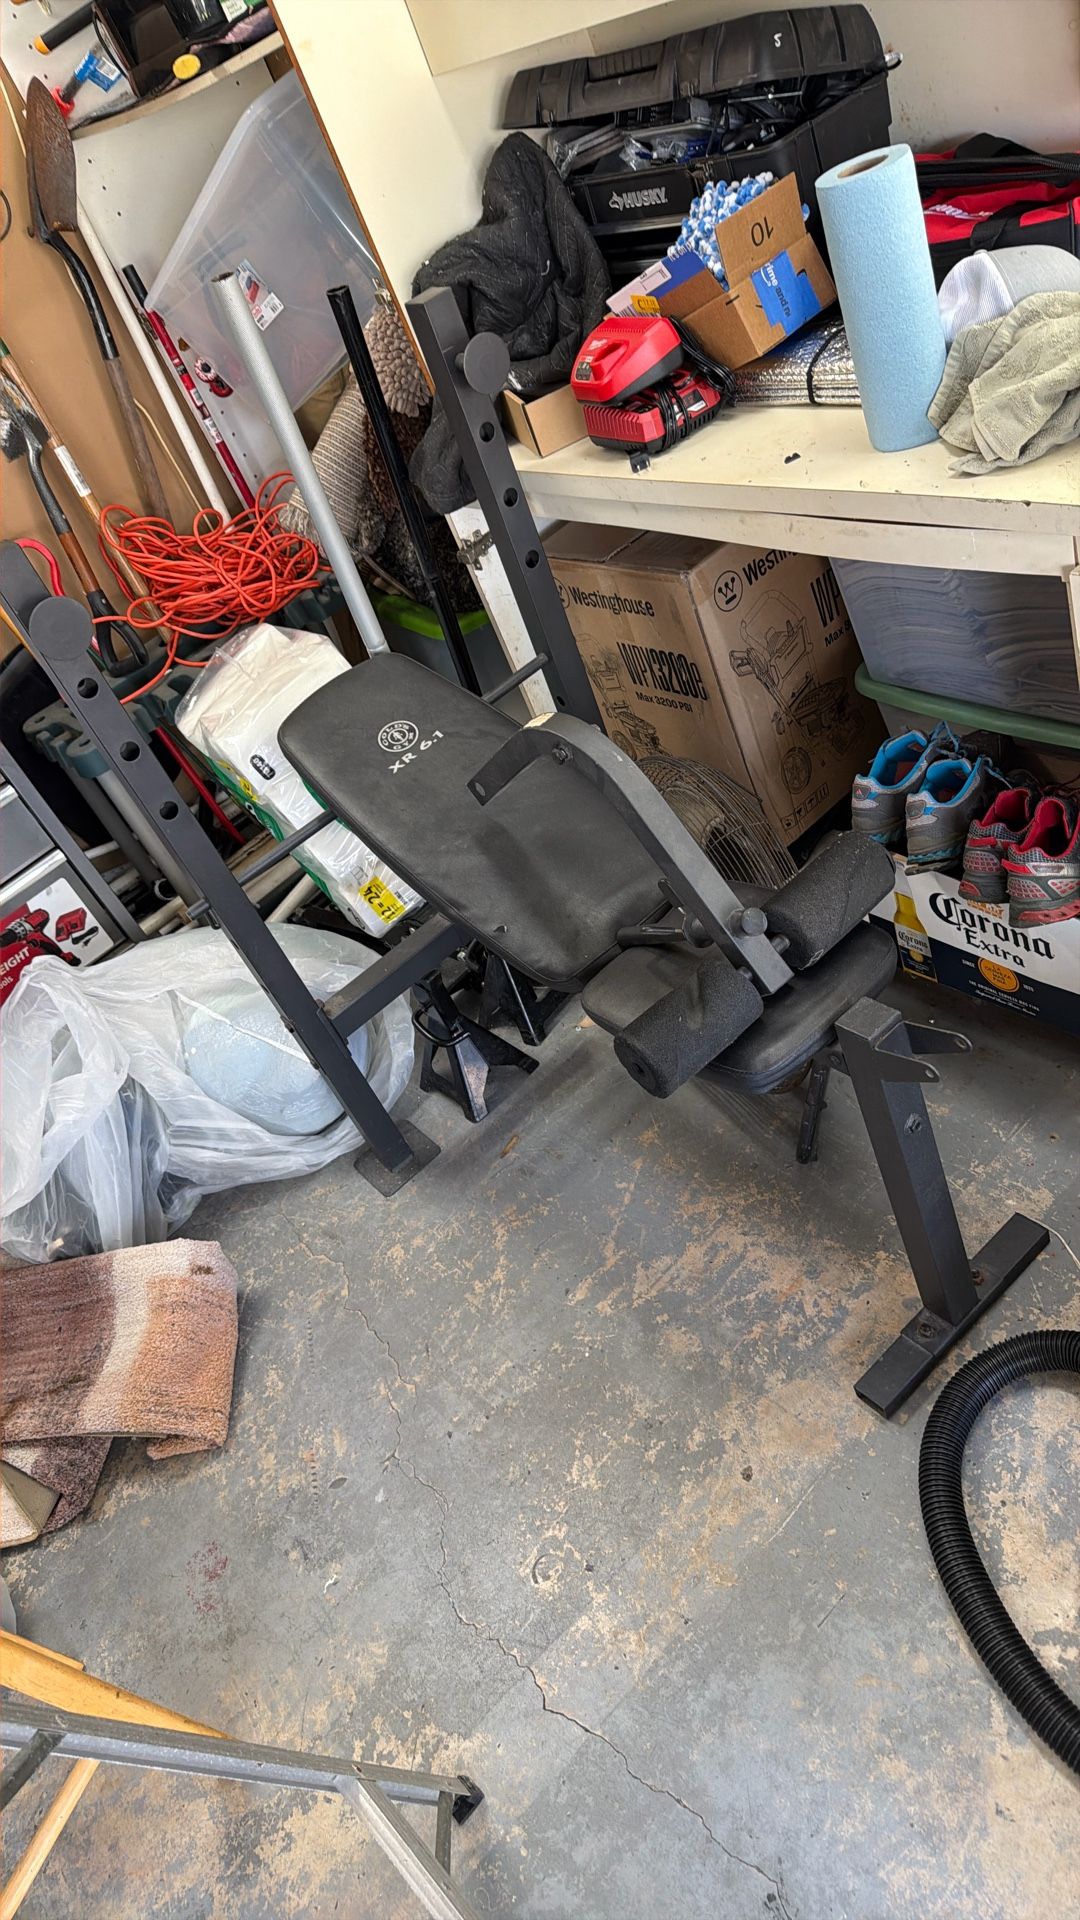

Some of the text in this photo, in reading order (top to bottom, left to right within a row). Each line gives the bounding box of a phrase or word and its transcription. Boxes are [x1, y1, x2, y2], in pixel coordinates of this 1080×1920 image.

[622, 186, 668, 208] HUSKY
[751, 216, 773, 247] 10
[568, 585, 655, 617] Westinghouse
[635, 691, 694, 713] Max 3200 PSI
[387, 730, 444, 774] XR 6.1
[364, 886, 380, 904] 24
[929, 892, 1055, 960] Corona
[964, 927, 1026, 968] Extra
